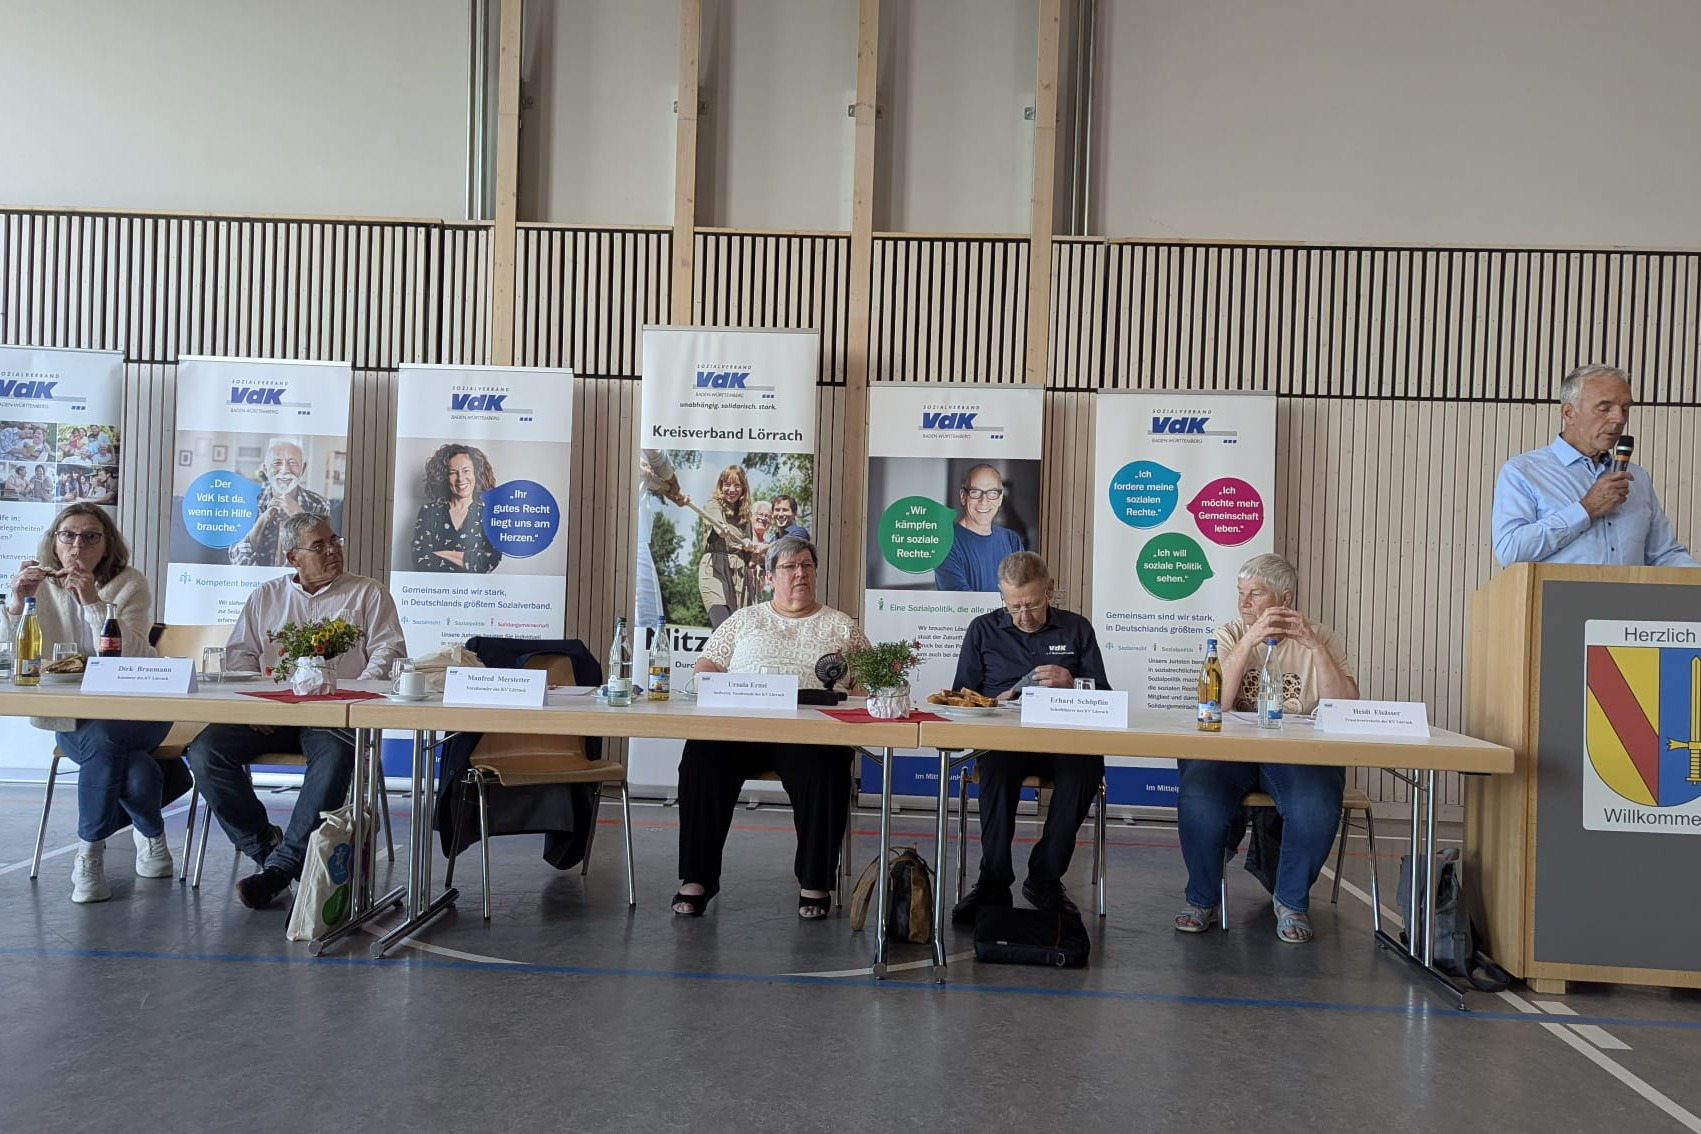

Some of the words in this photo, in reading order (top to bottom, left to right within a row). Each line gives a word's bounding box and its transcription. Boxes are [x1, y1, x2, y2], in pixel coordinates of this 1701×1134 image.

[0, 371, 60, 379] OZIALVERBAND
[696, 371, 750, 389] VdK
[230, 387, 287, 405] VdK
[451, 393, 508, 411] VdK
[680, 401, 720, 410] unabhängig.
[721, 402, 757, 410] solidarisch.
[758, 402, 777, 410] stark.
[922, 412, 979, 430] VdK
[1152, 417, 1210, 434] VdK
[652, 425, 744, 440] Kreisverband
[749, 428, 803, 441] Lörrach
[1134, 470, 1152, 479] „Ich
[1113, 482, 1144, 491] fordere
[1146, 483, 1174, 491] meine
[1218, 486, 1236, 496] „Ich
[196, 493, 214, 503] VdK
[217, 493, 228, 503] ist
[231, 494, 246, 504] da,
[509, 489, 528, 500] „Ihr
[1126, 495, 1161, 504] sozialen
[1201, 498, 1234, 508] möchte
[1236, 500, 1260, 509] mehr
[188, 508, 212, 517] wenn
[215, 508, 229, 517] ich
[231, 508, 252, 518] Hilfe
[493, 505, 520, 515] gutes
[522, 504, 550, 514] Recht
[905, 506, 927, 516] „Wir
[1126, 507, 1162, 517] Rechte.“
[1198, 511, 1259, 521] Gemeinschaft
[491, 517, 512, 528] liegt
[514, 520, 532, 528] uns
[534, 520, 550, 528] am
[895, 519, 937, 531] kämpfen
[1214, 524, 1244, 534] leben.“
[500, 532, 539, 543] Herzen.“
[891, 534, 904, 543] für
[907, 534, 939, 544] soziale
[896, 548, 936, 559] Rechte.“
[1153, 548, 1170, 558] „Ich
[1172, 549, 1187, 557] will
[1143, 561, 1173, 570] soziale
[1175, 562, 1202, 571] Politik
[1156, 573, 1189, 583] sehen.“
[196, 579, 238, 588] Kompetent
[241, 580, 260, 588] berat
[402, 586, 450, 594] Gemeinsam
[451, 586, 469, 595] sind
[484, 588, 507, 597] stark,
[410, 599, 462, 608] Deutschlands
[463, 600, 496, 609] größtem
[497, 601, 553, 610] Sozialverband.
[890, 604, 906, 612] Eine
[907, 604, 955, 613] Sozialpolitik,
[1105, 611, 1156, 620] Gemeinsam
[1157, 612, 1175, 621] sind
[1177, 613, 1189, 621] wir
[1191, 613, 1215, 622] stark,
[1105, 624, 1113, 632] in
[1115, 624, 1168, 633] Deutschlands
[1170, 625, 1203, 635] größtem
[1624, 627, 1696, 644] Herzlich
[675, 660, 697, 669] Durc
[467, 674, 495, 682] Manfred
[1050, 696, 1074, 704] Erhard
[1077, 698, 1109, 706] Schöpflin
[1604, 807, 1701, 827] Willkomme
